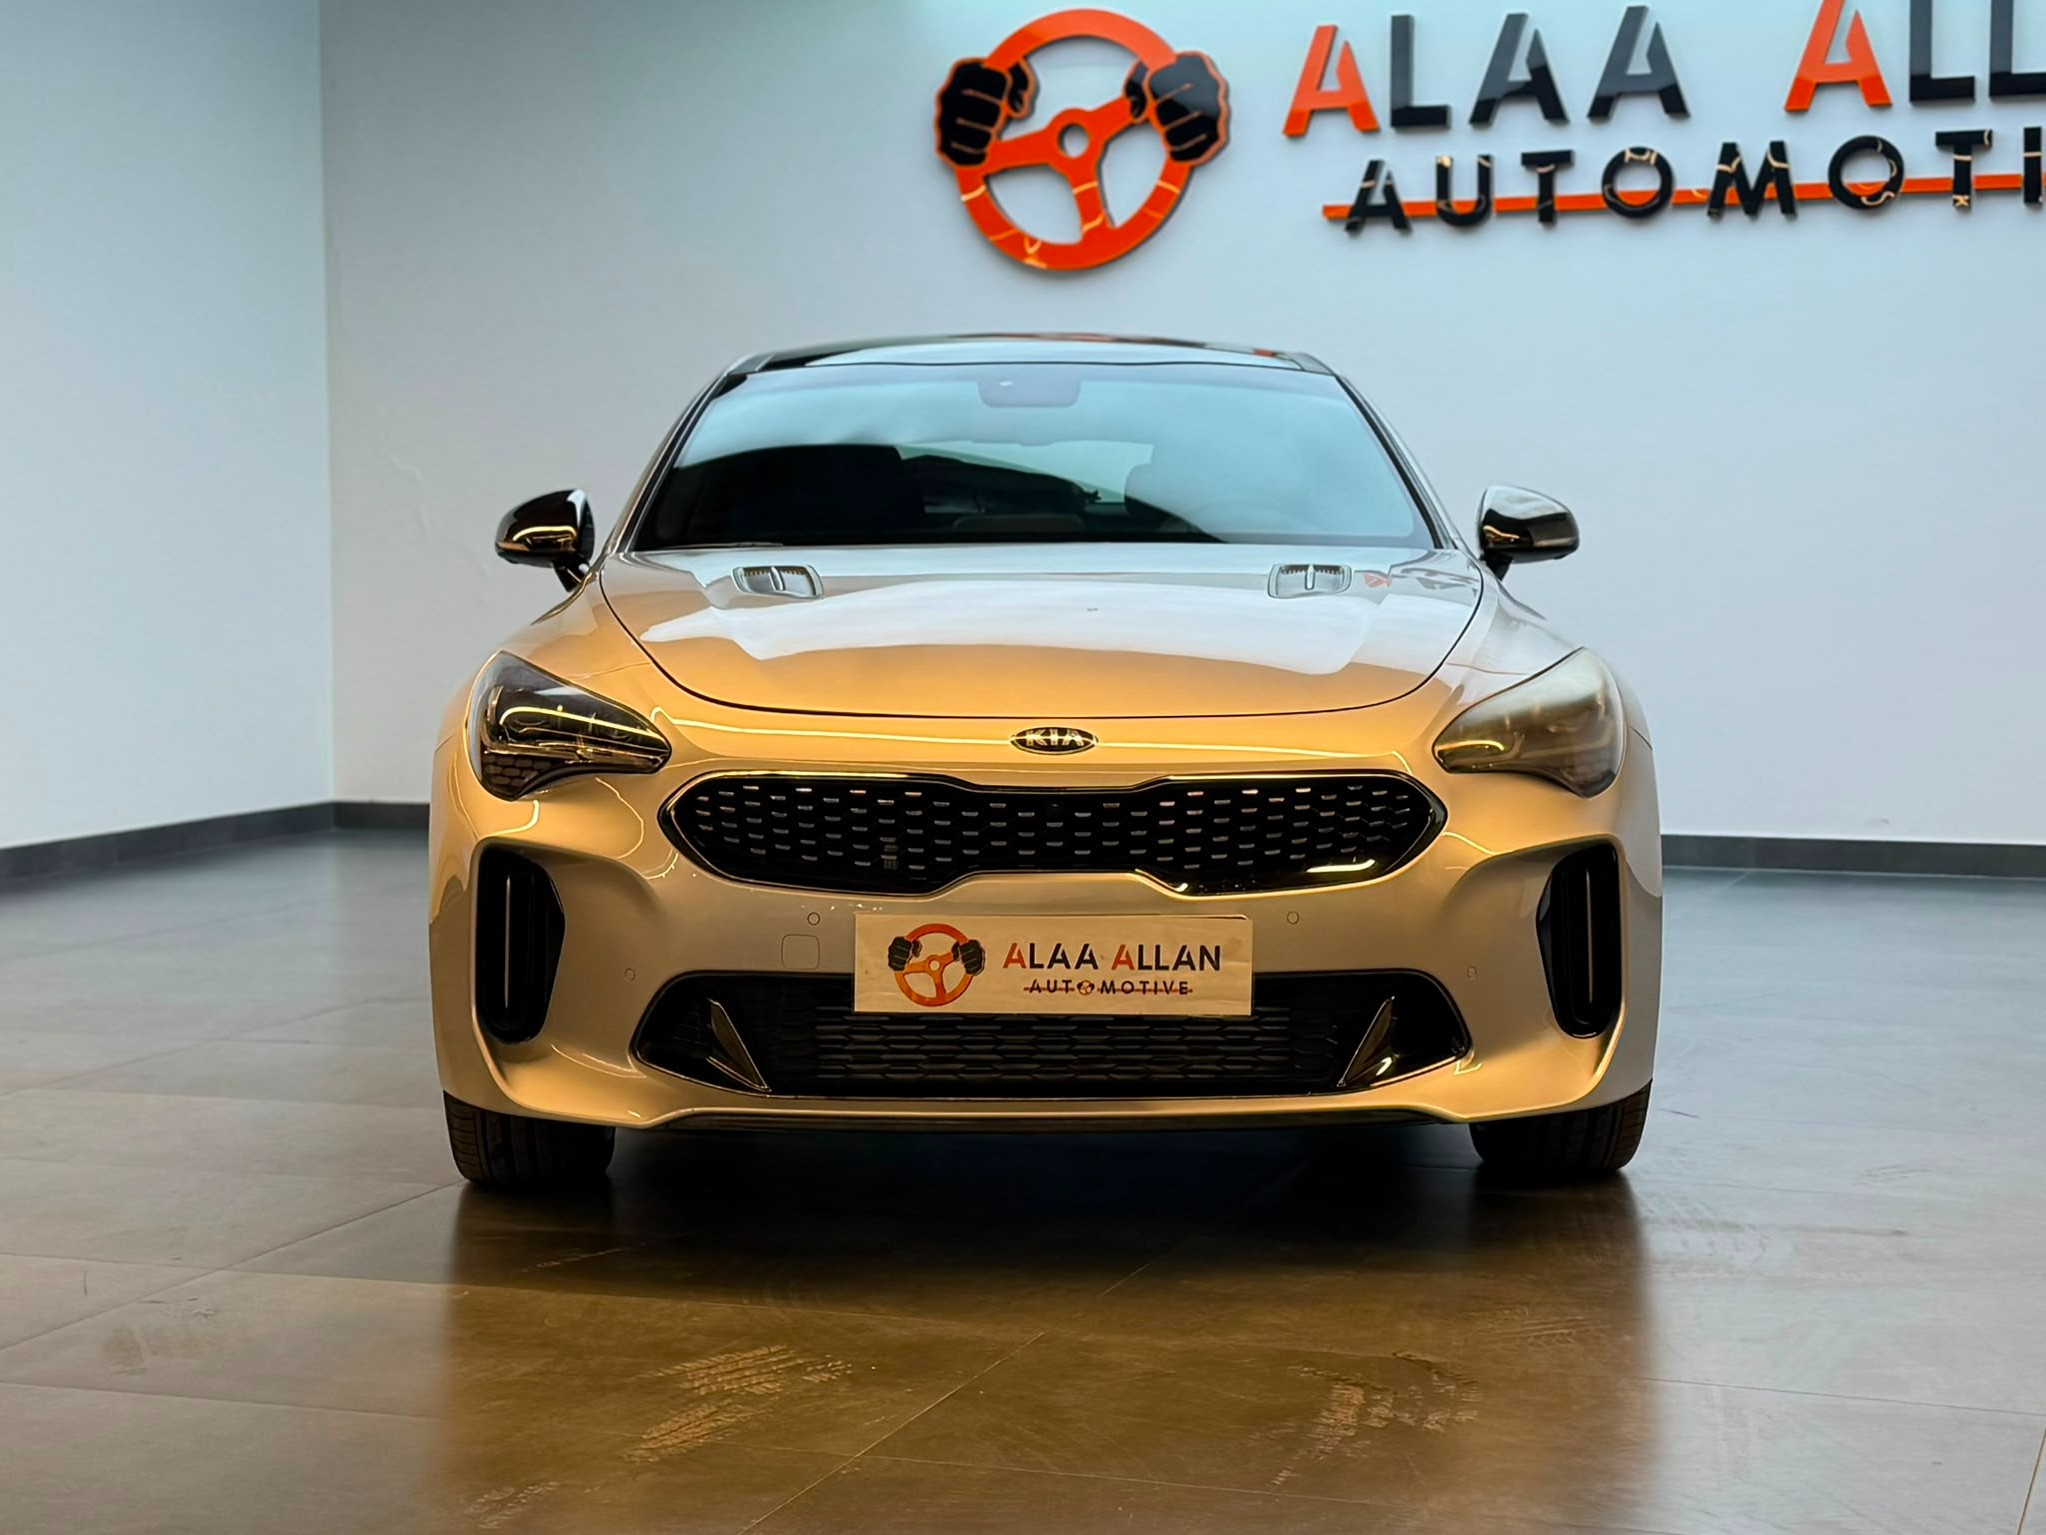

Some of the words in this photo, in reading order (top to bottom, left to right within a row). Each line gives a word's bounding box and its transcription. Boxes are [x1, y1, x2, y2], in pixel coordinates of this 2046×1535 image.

[1283, 5, 1690, 136] ALAA
[1345, 126, 2043, 233] AUTOMOTI
[1025, 728, 1085, 746] KIA
[1002, 942, 1099, 970] ALAA
[1111, 943, 1221, 971] ALLAN
